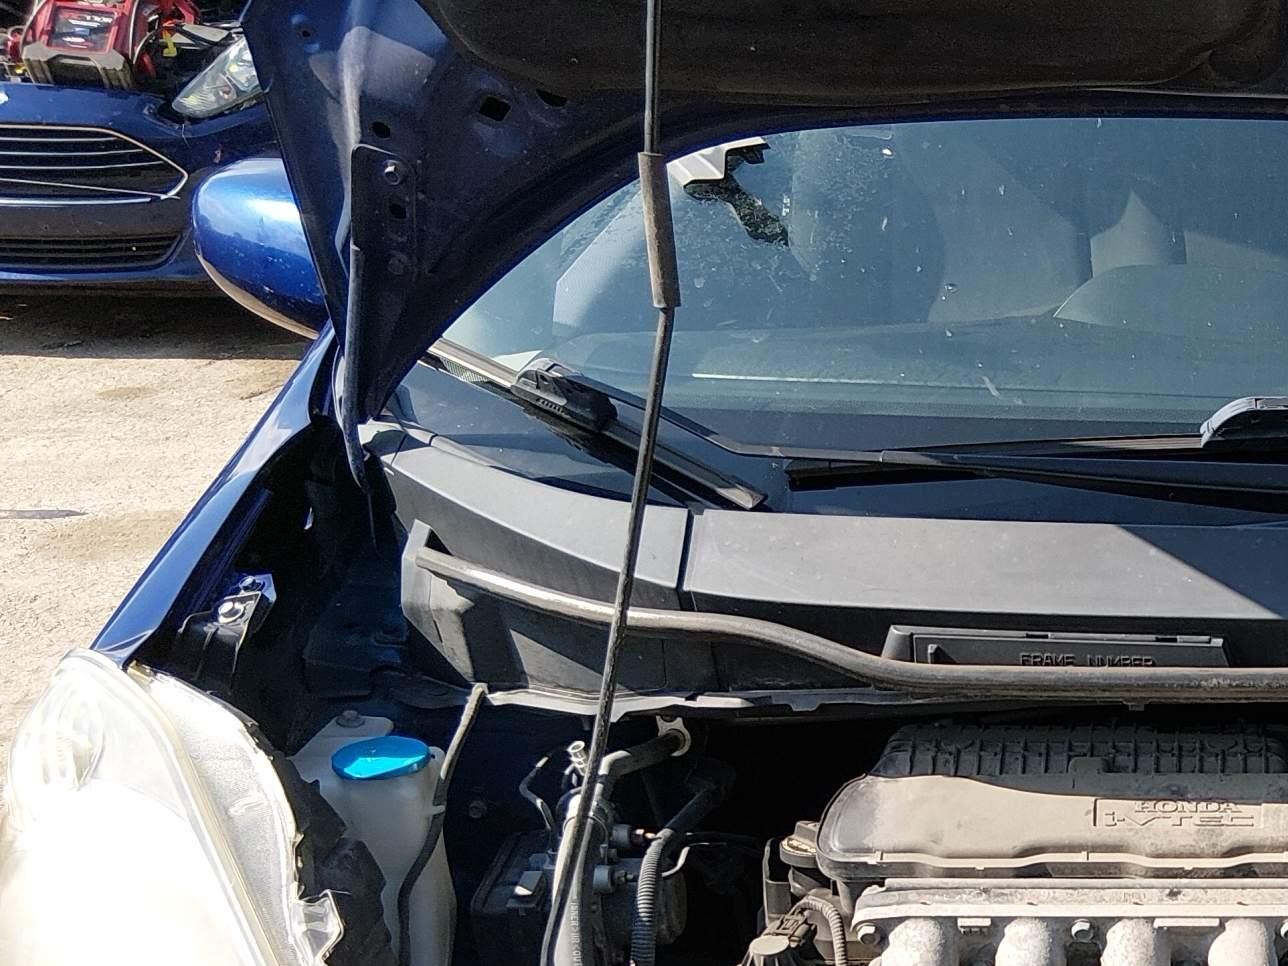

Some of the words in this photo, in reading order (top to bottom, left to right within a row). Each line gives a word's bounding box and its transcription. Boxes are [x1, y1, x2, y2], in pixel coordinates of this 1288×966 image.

[1019, 652, 1075, 667] FRAME
[1134, 800, 1242, 814] HONDA
[1104, 811, 1255, 828] i-VTEC
